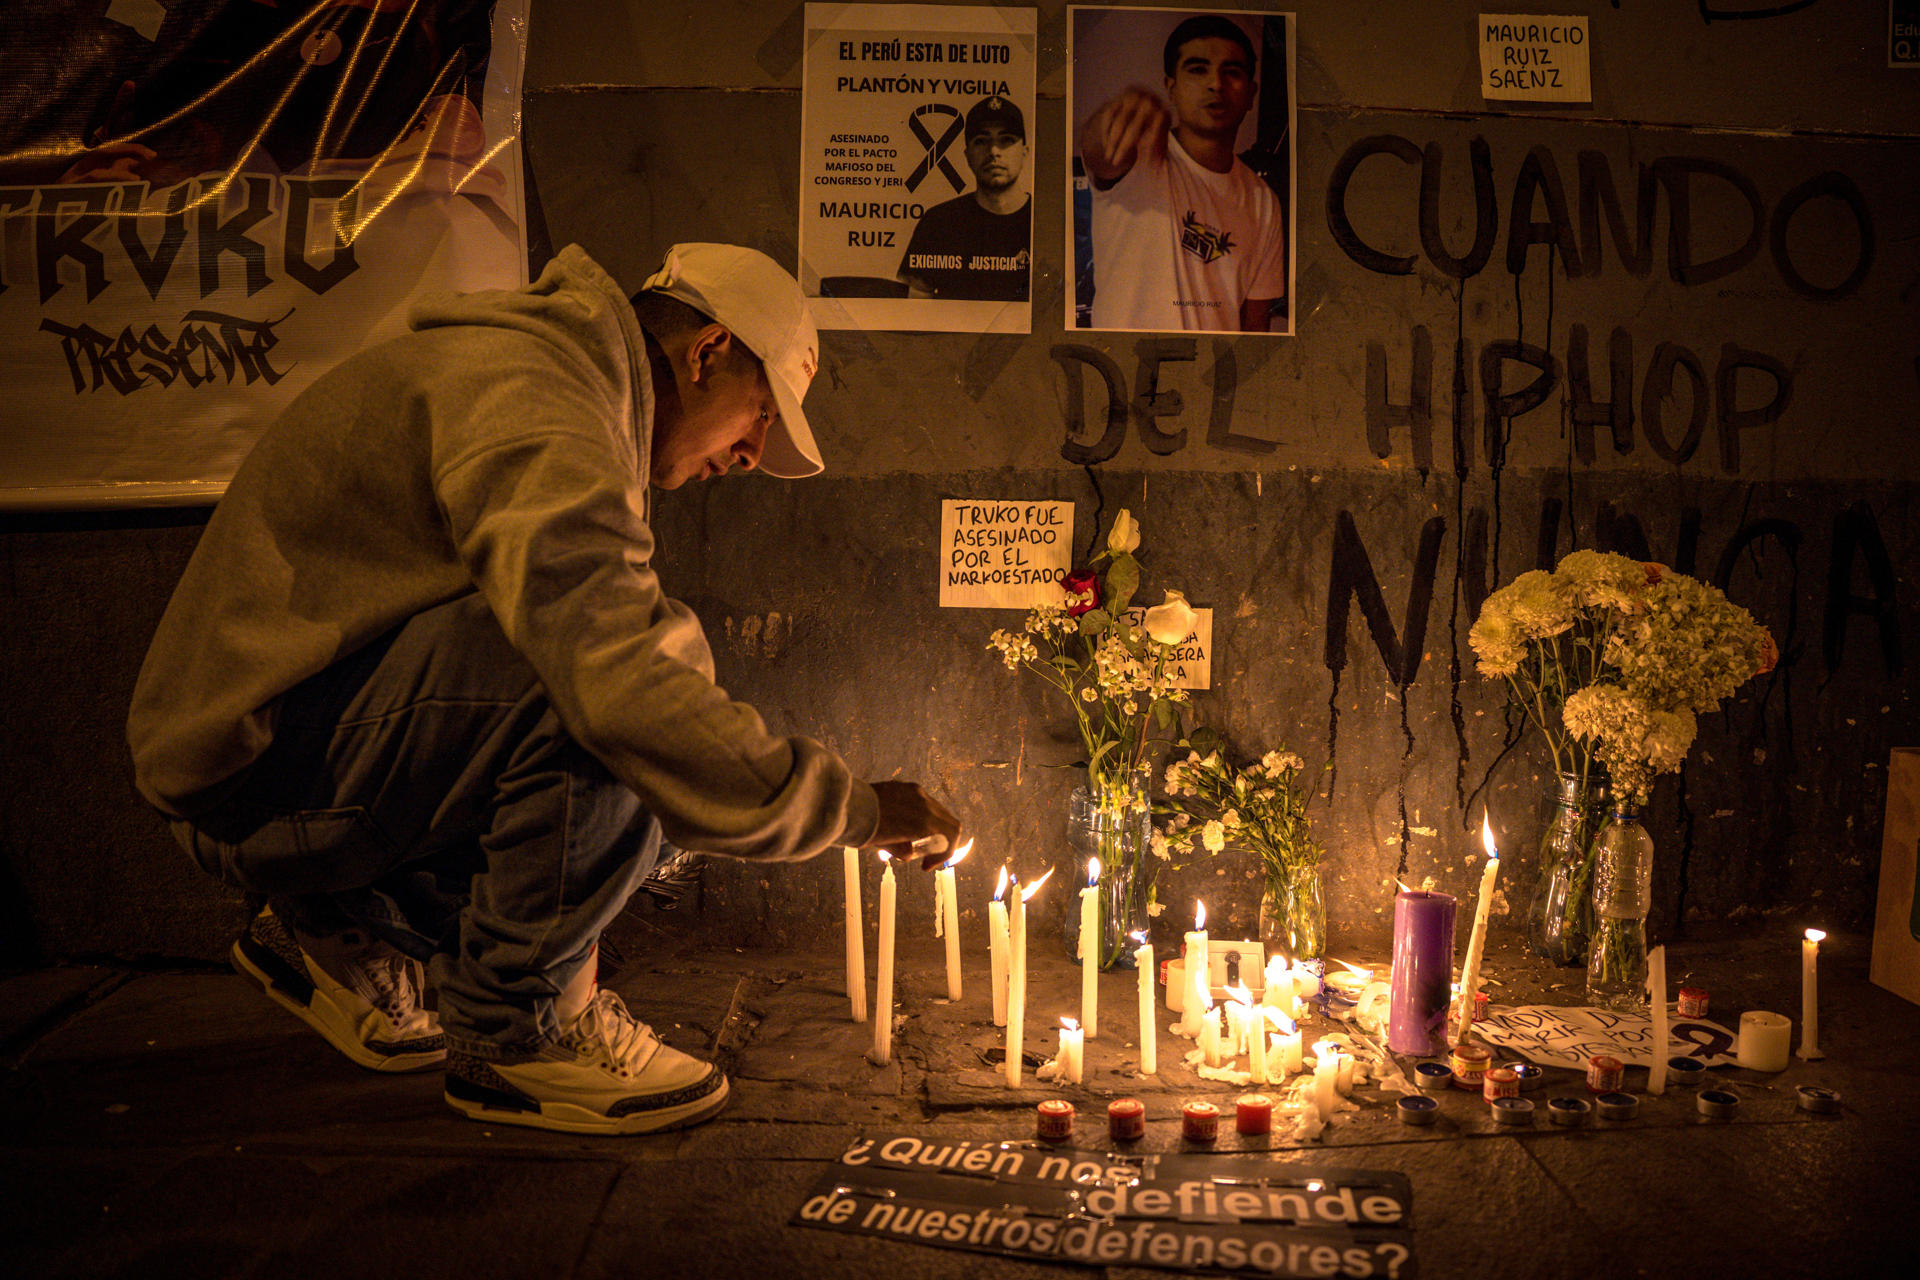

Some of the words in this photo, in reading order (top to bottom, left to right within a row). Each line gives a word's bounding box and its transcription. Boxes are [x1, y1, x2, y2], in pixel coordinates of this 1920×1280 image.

[1486, 24, 1584, 45] MAURICIO
[838, 40, 859, 62] EL
[861, 38, 902, 63] PERÚ
[906, 42, 943, 63] ESTA
[949, 42, 970, 64] DE
[974, 43, 1010, 65] LUTO
[1504, 46, 1553, 66] RUIZ
[837, 73, 924, 95] PLANTÓN
[928, 78, 940, 94] Y
[943, 78, 1011, 96] VIGILIA
[830, 134, 889, 144] ASESINADO
[824, 148, 846, 157] POR
[849, 149, 860, 158] EL
[863, 149, 897, 158] PACTO
[825, 162, 873, 172] MAFIOSO
[876, 163, 895, 172] DEL
[814, 176, 871, 186] CONGRESO
[874, 177, 881, 186] Y
[882, 177, 903, 188] JERI
[819, 202, 924, 219] MAURICIO
[1325, 134, 1876, 298] CUANDO
[848, 231, 896, 248] RUIZ
[908, 254, 962, 270] EXIGIMOS
[968, 256, 1017, 271] JUSTICIA
[1172, 300, 1205, 308] MAURICIO
[1050, 337, 1287, 466] DEL
[1025, 505, 1064, 526] FUE
[953, 527, 1057, 548] ASESINADO
[952, 549, 991, 568] POR
[1003, 548, 1029, 567] EL
[948, 567, 1067, 587] NARKOESTADO
[841, 1134, 1021, 1180] ¿Quién
[1086, 1180, 1402, 1225] defiende
[799, 1189, 851, 1226] de
[861, 1198, 1054, 1254] nuestros
[1065, 1220, 1410, 1280] defensores?
